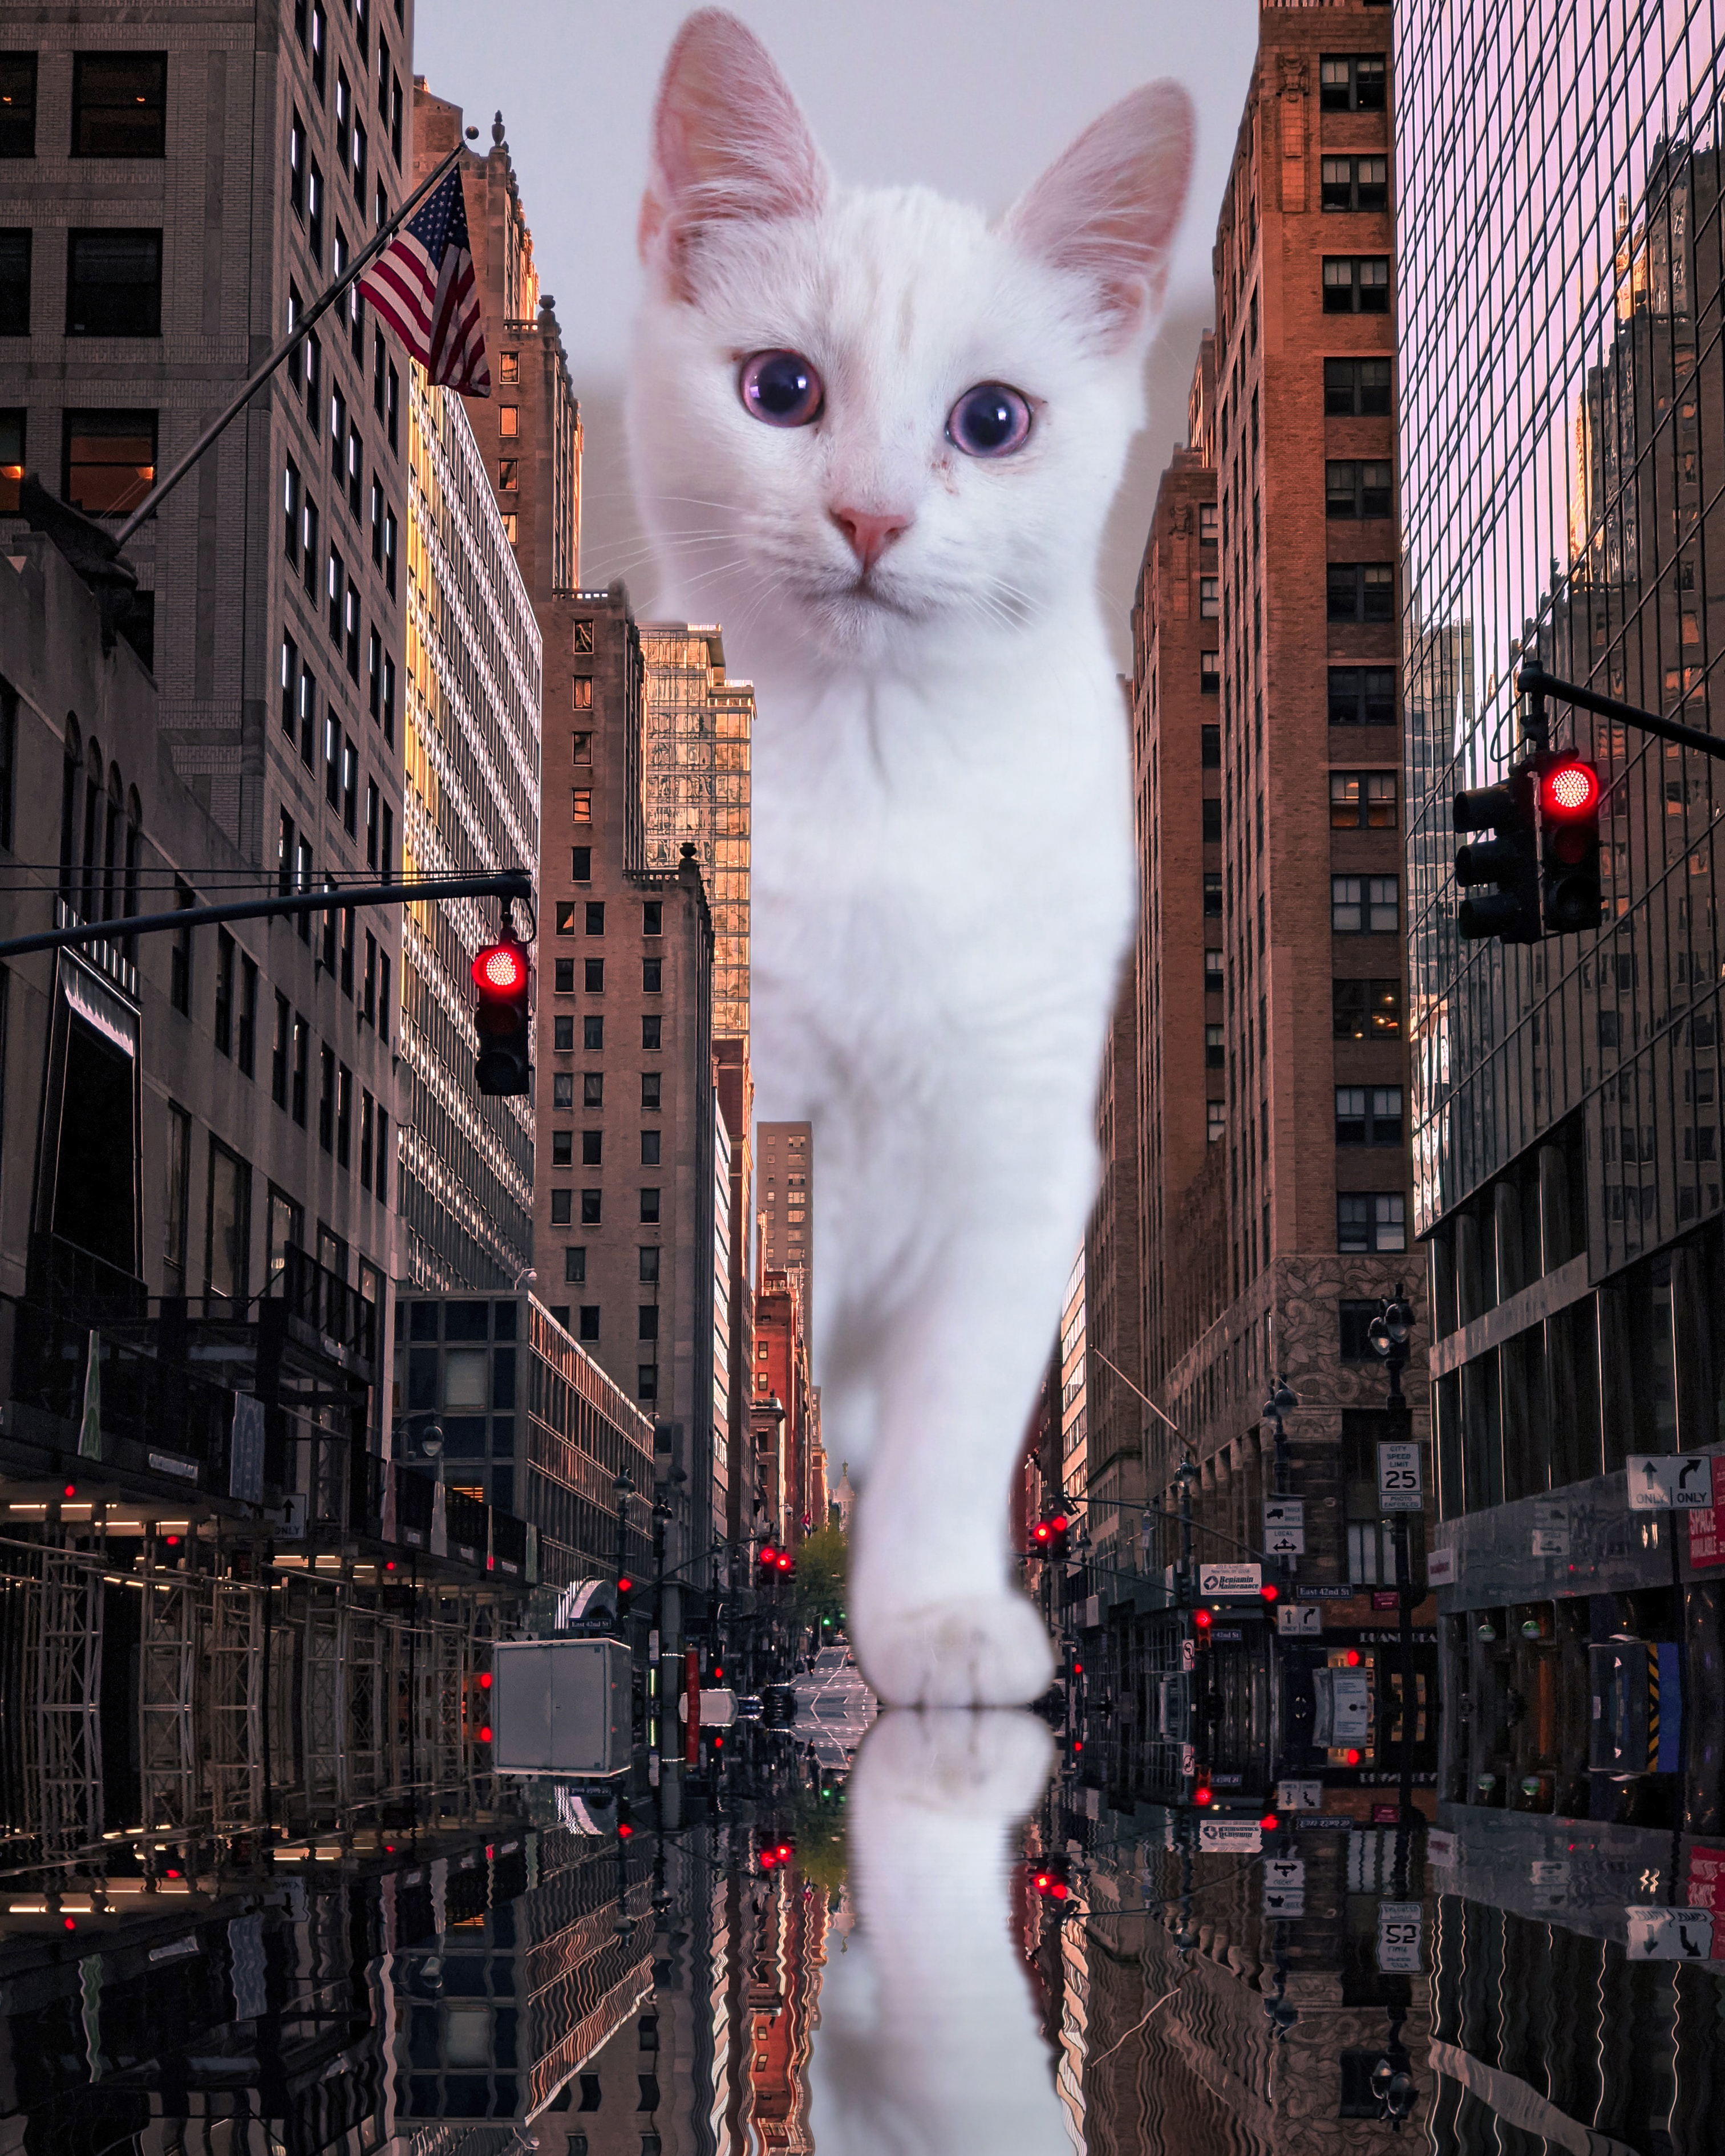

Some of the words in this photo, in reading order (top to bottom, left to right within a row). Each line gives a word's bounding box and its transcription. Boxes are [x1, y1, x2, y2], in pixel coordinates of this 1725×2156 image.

[1385, 1470, 1416, 1489] 25
[1636, 1493, 1667, 1504] ONLY
[1677, 1492, 1707, 1503] ONLY
